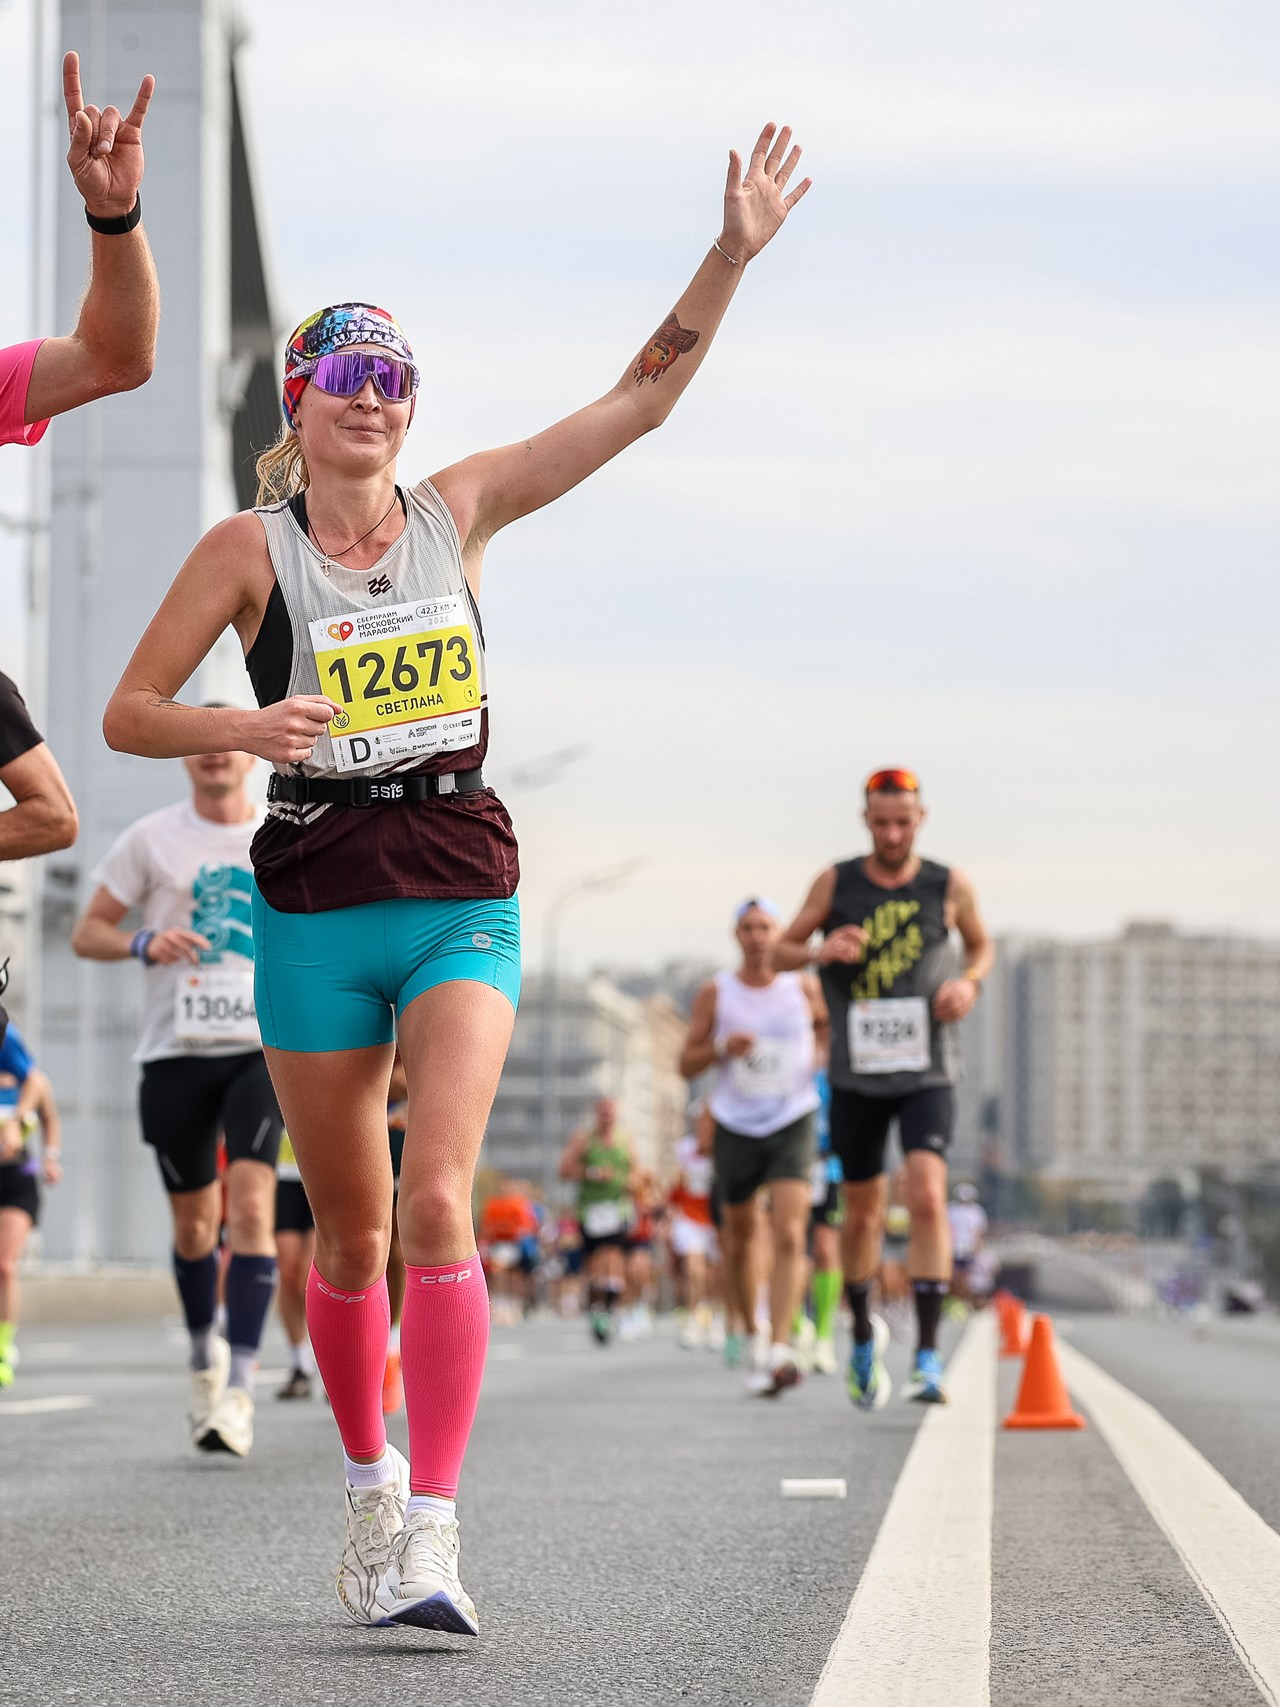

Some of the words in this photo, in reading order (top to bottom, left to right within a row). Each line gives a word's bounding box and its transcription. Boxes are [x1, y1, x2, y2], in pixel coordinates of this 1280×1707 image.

[357, 614, 413, 631] МОСКОВСКИЙ
[359, 625, 401, 639] МАРАФОН
[328, 636, 472, 704] 12673
[376, 693, 444, 716] СВЕТЛАНА
[349, 737, 372, 764] D
